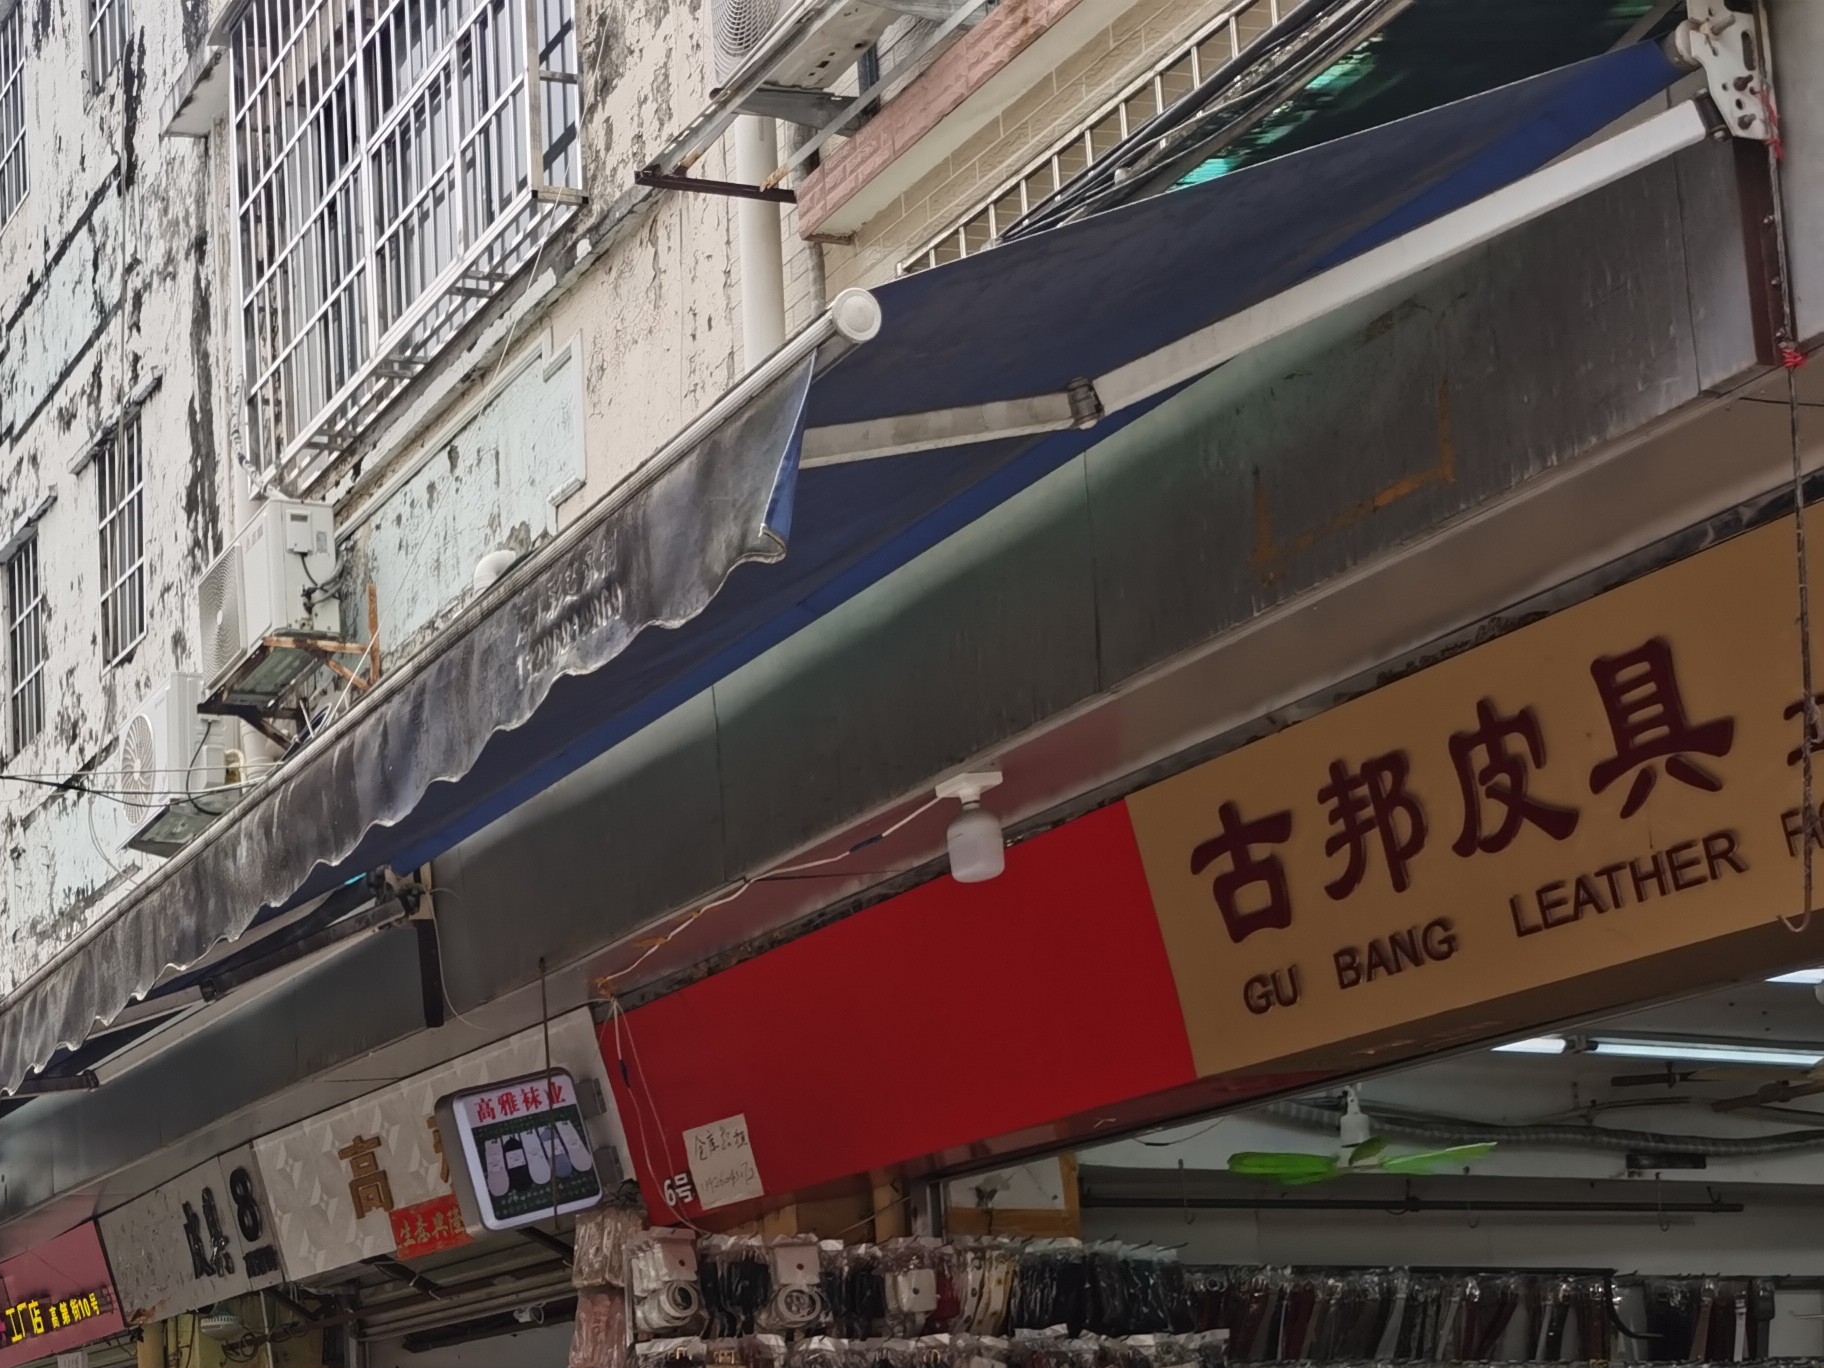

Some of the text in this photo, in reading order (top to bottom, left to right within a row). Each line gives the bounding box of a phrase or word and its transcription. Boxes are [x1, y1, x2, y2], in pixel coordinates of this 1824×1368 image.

[1190, 636, 1736, 943] 古邦皮具
[1243, 966, 1300, 1015] GU
[1333, 918, 1458, 990] BANG
[1509, 829, 1749, 937] LEATHER
[474, 1082, 566, 1122] 高雅袜业
[664, 1173, 693, 1206] 6号
[5, 1300, 44, 1343] 工厂店
